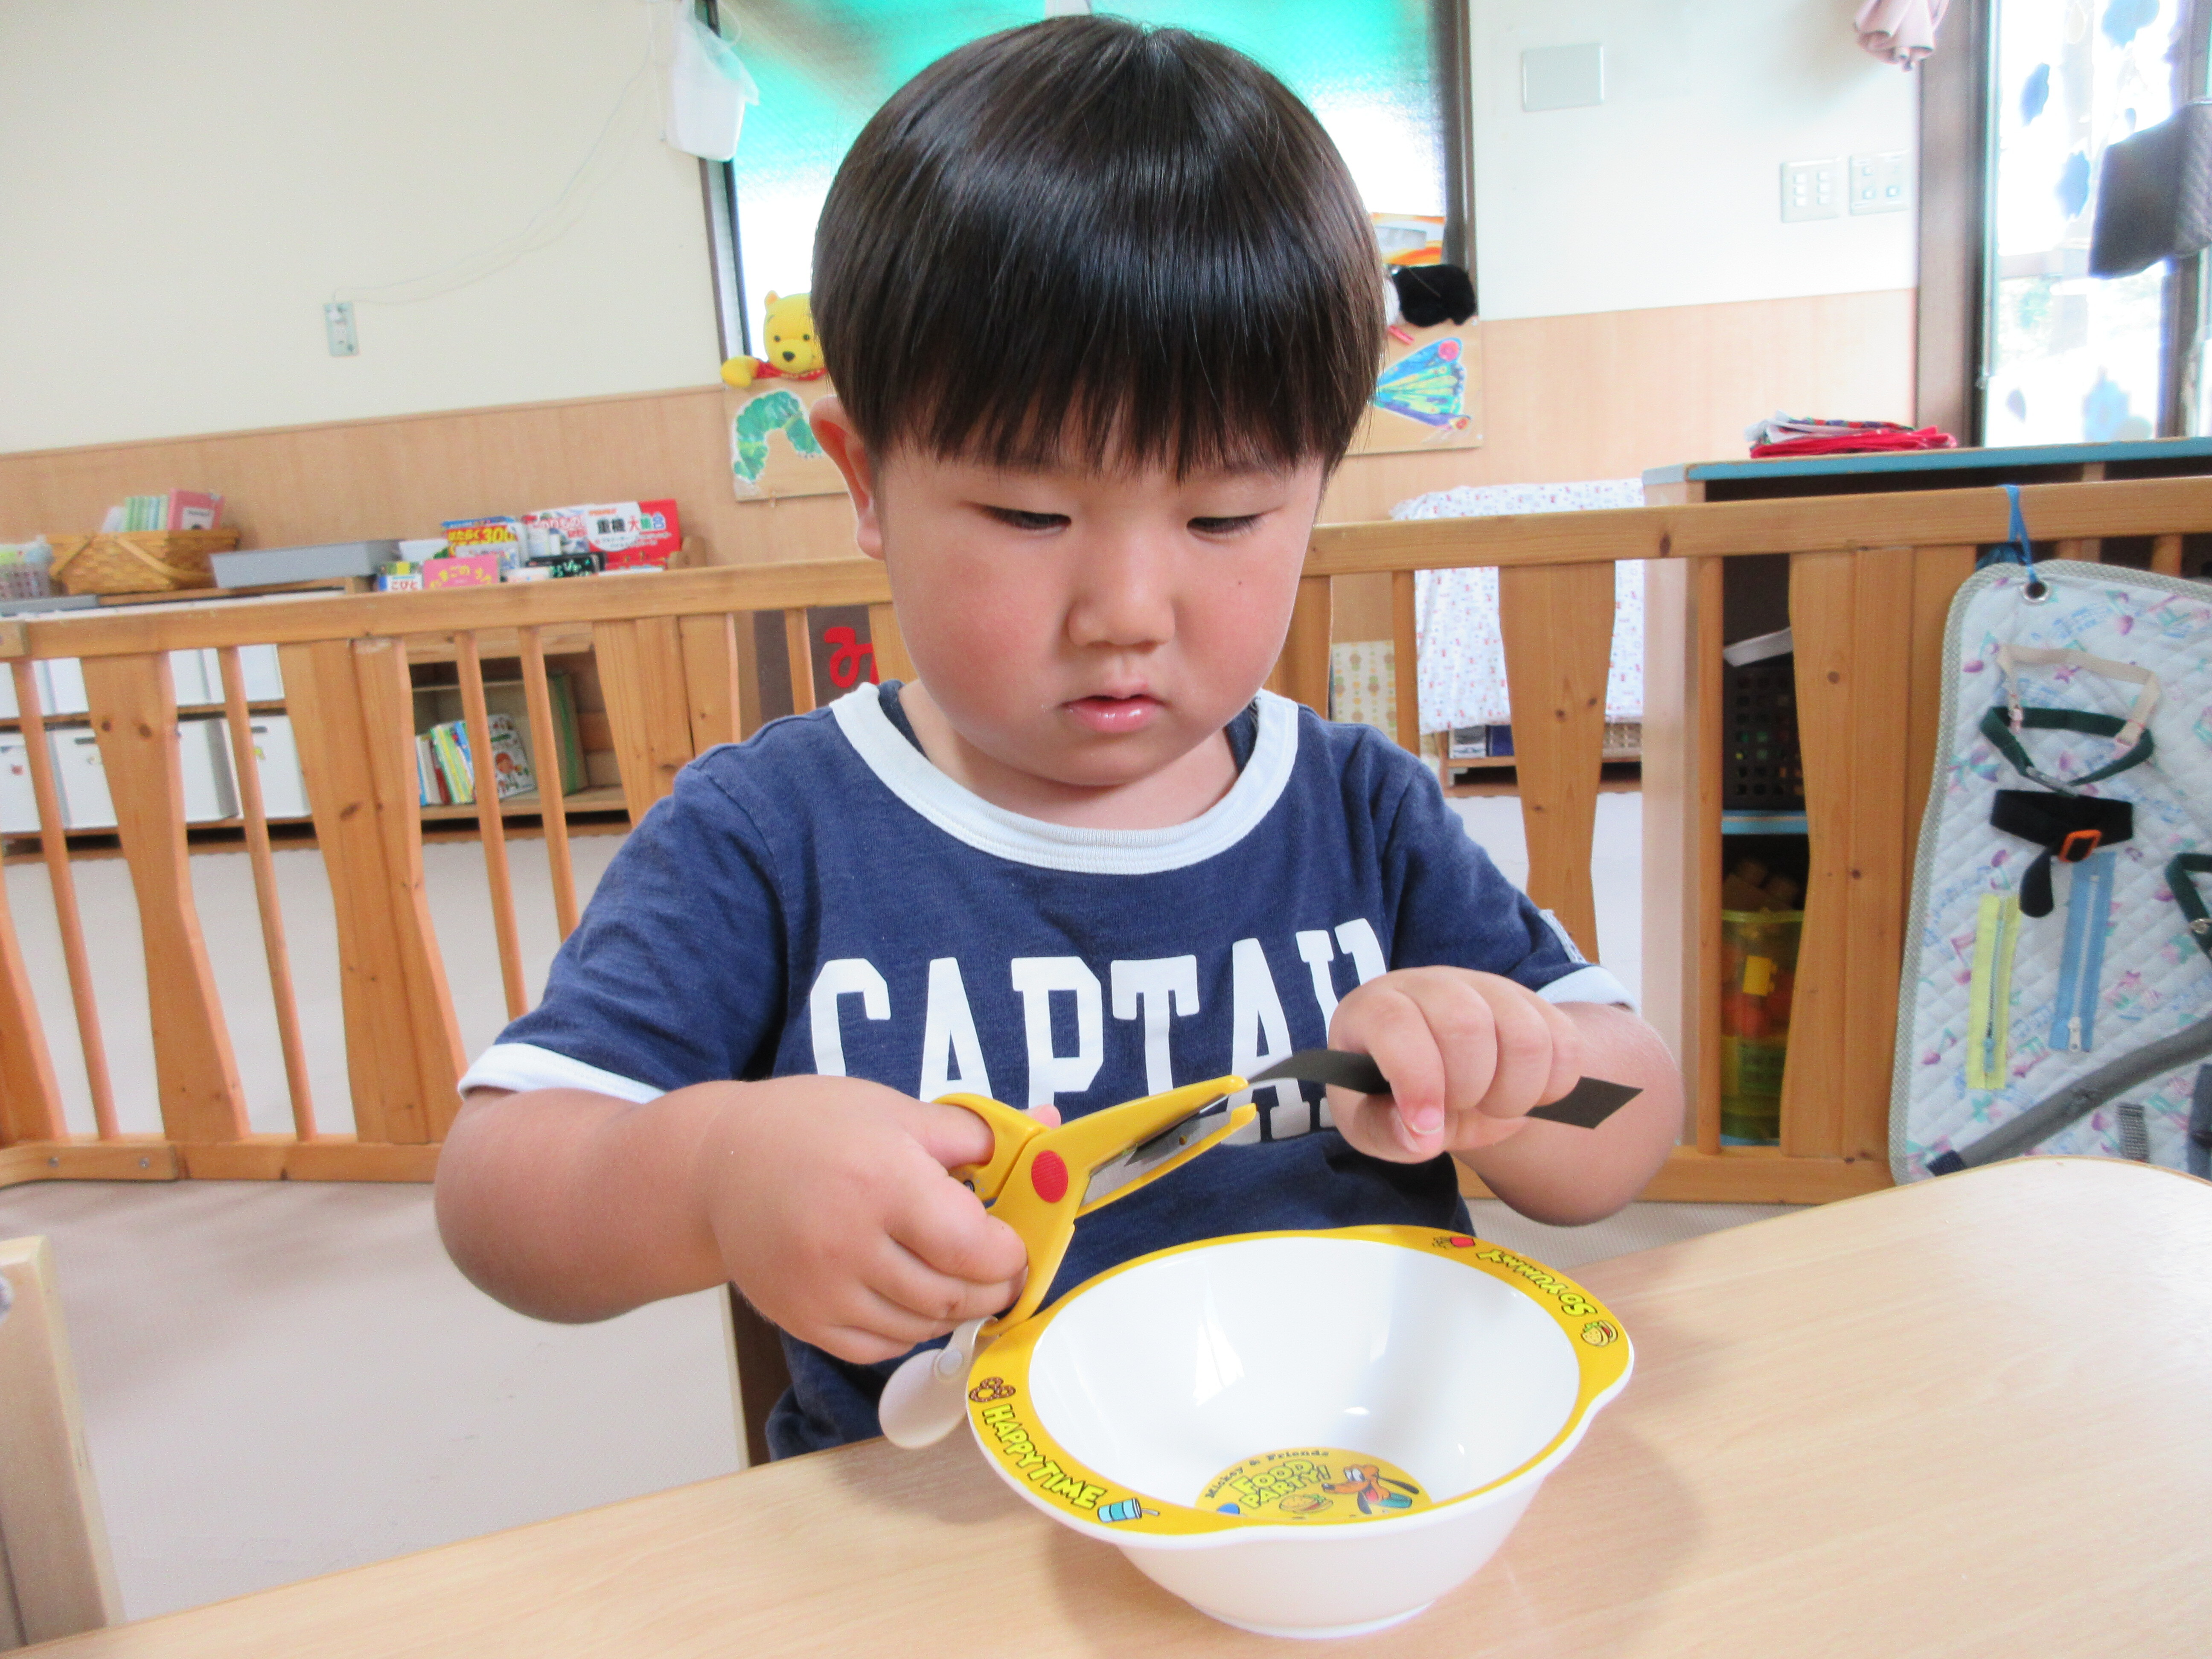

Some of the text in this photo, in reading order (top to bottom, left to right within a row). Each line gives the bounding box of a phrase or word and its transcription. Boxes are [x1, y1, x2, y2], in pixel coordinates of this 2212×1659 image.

[809, 918, 1388, 1145] CAPTAI
[1476, 1249, 1598, 1316] SO YUMMY
[982, 1403, 1108, 1510] HAPPY TIME
[1229, 1459, 1315, 1495] FOOD
[1239, 1464, 1330, 1509] PARTY!
